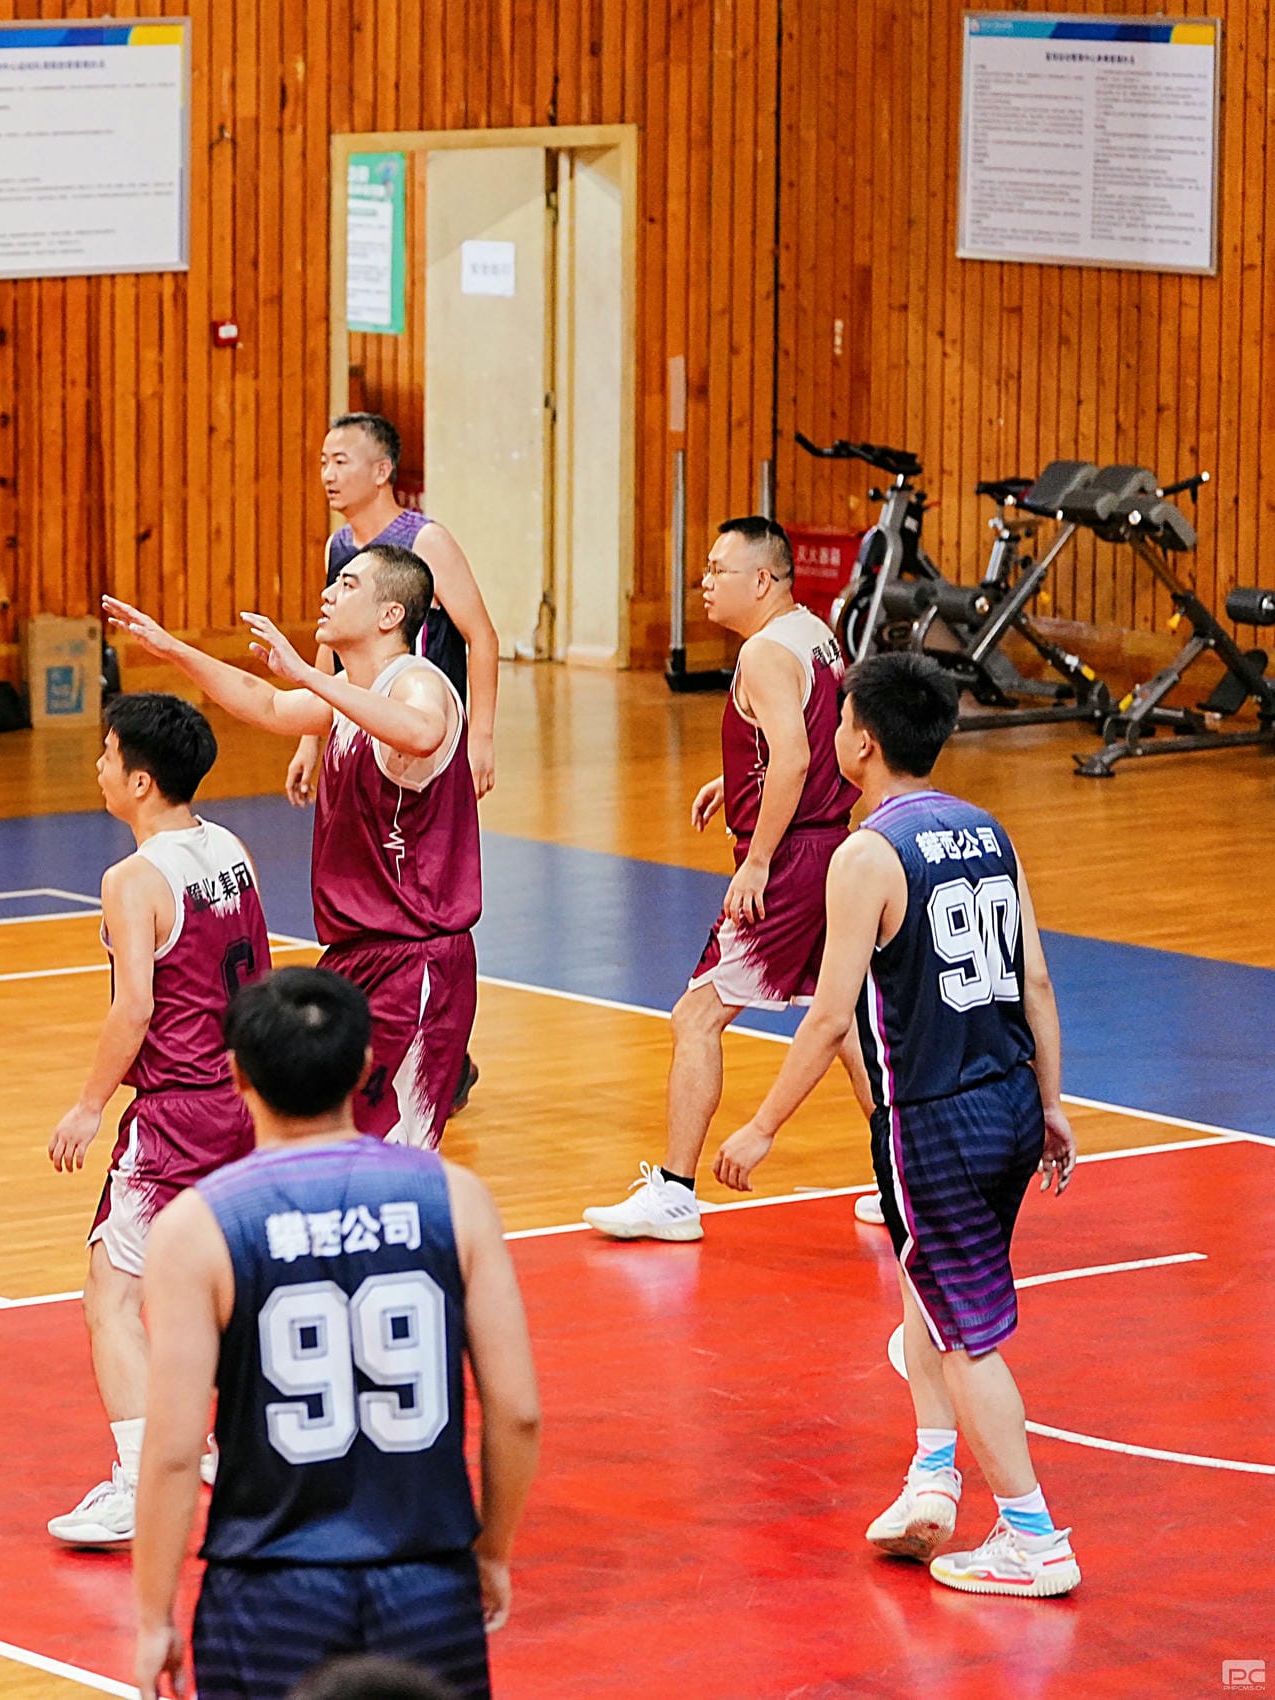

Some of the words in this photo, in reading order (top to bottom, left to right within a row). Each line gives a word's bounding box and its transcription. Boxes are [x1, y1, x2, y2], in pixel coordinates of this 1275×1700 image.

[915, 826, 1003, 865] 攀西公司
[926, 874, 1021, 1013] 90
[265, 1201, 422, 1263] 攀西公司
[258, 1269, 450, 1466] 99
